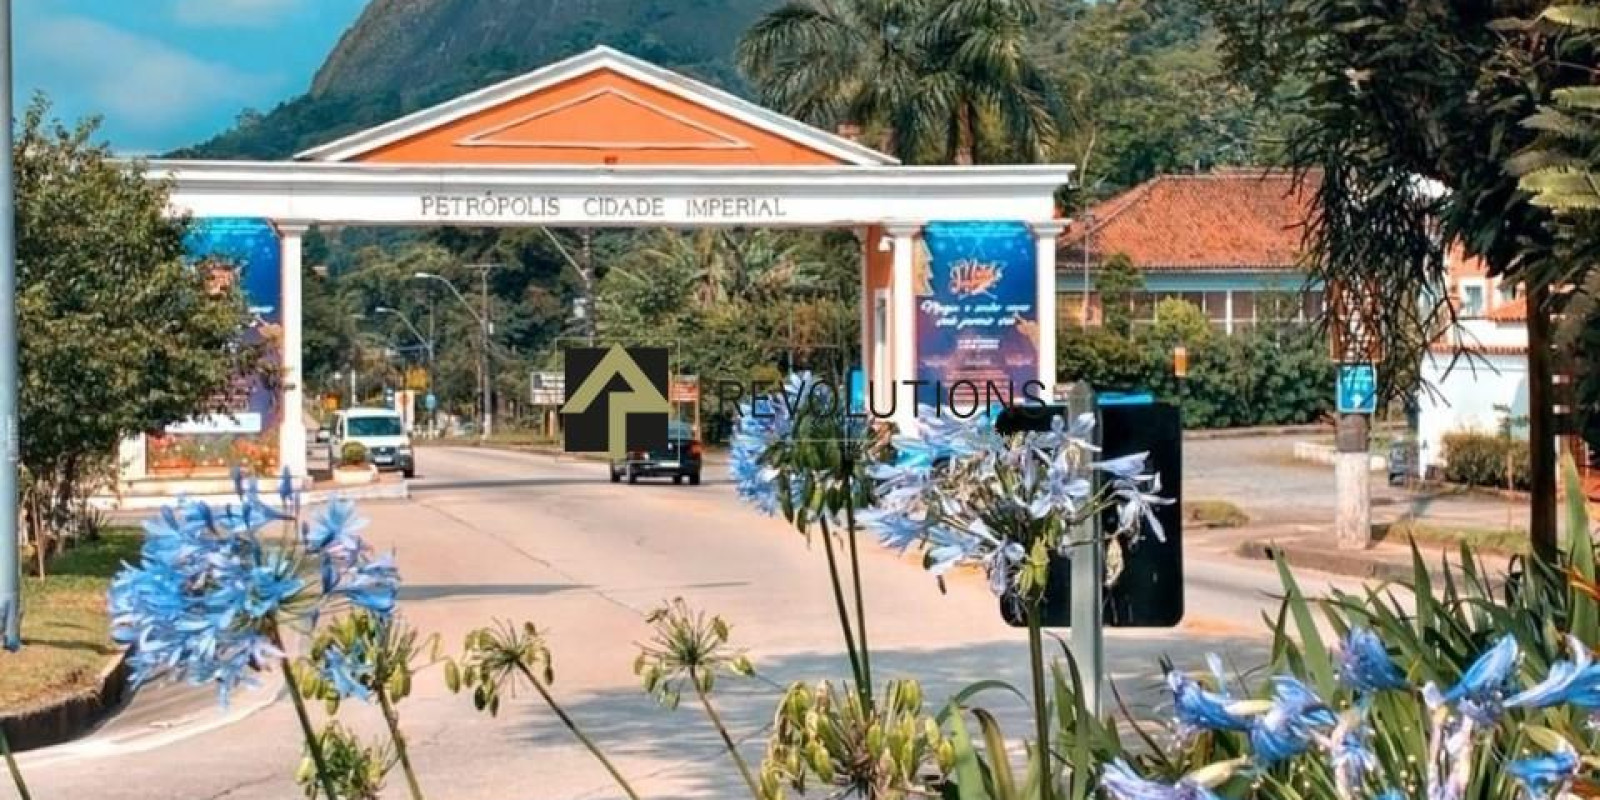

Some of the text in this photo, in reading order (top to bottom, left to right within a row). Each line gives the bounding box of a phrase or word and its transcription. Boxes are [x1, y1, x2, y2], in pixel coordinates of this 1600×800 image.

[420, 191, 787, 216] PETRÓPOLIS CIDADE IMPERIAL
